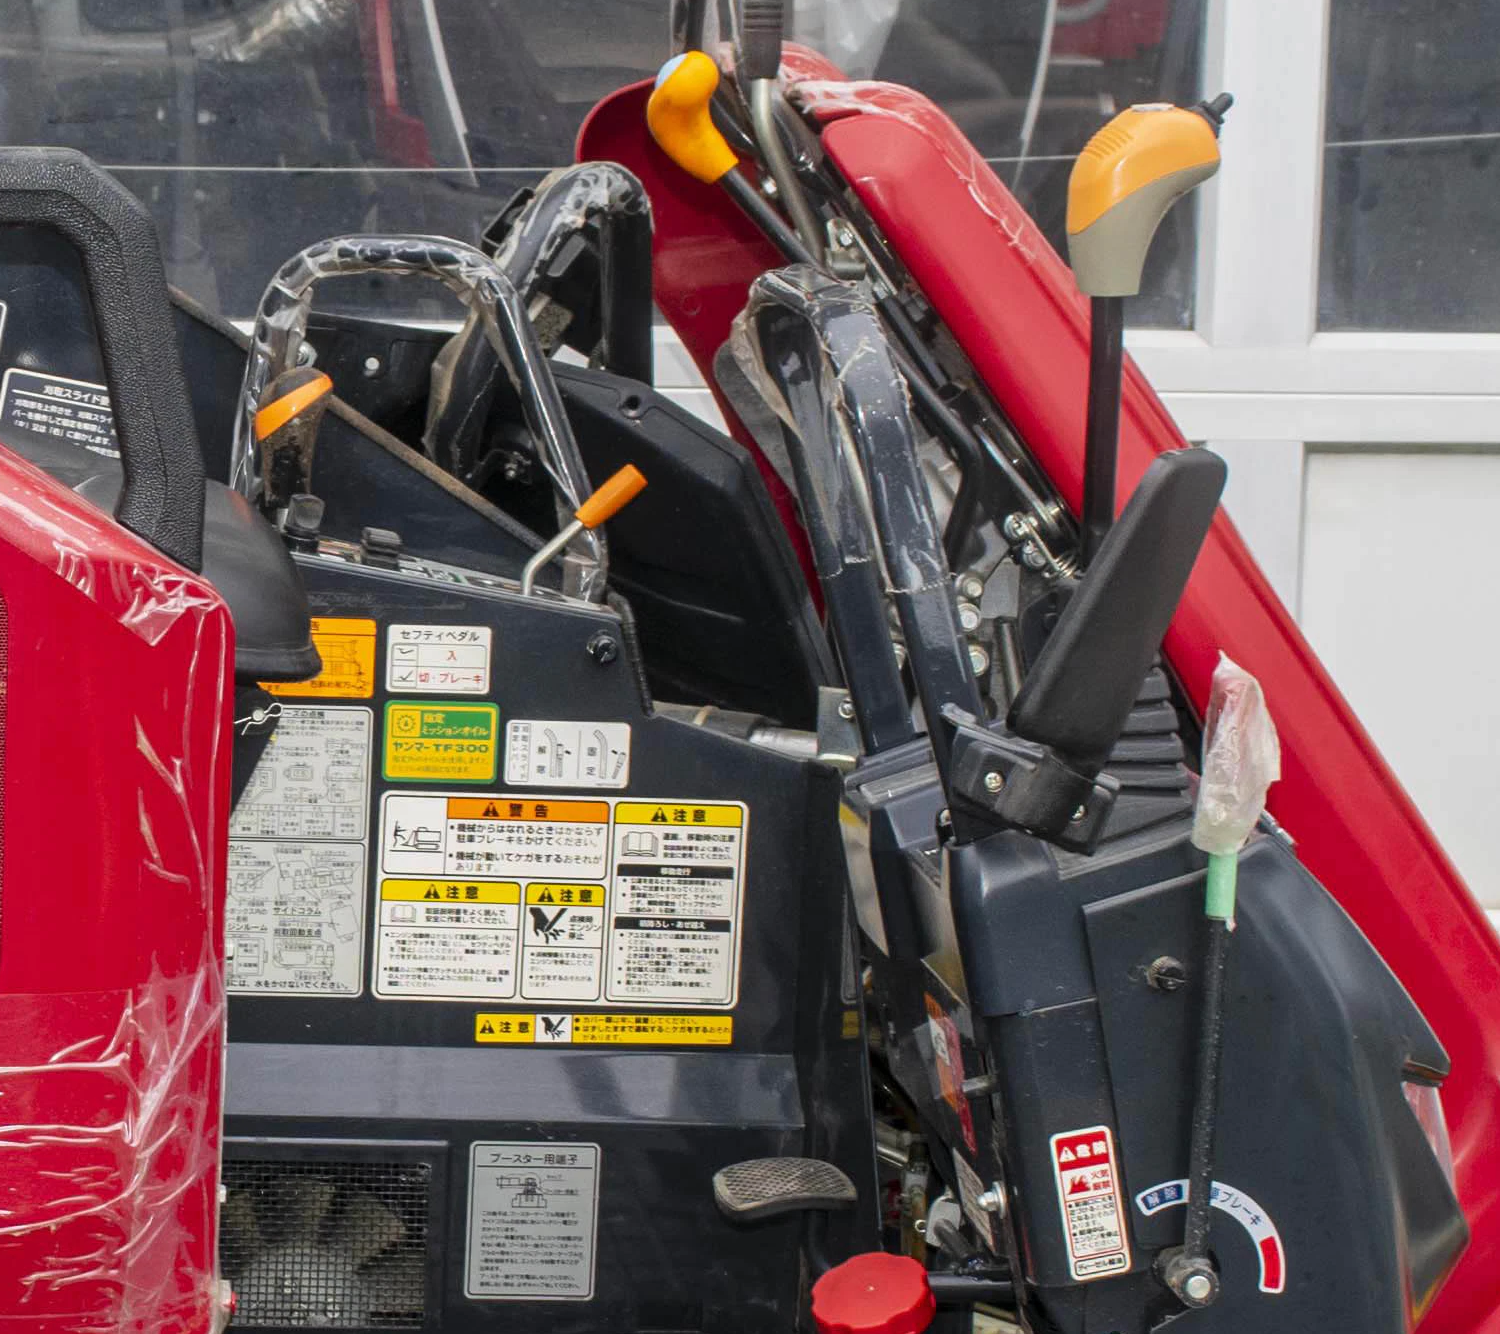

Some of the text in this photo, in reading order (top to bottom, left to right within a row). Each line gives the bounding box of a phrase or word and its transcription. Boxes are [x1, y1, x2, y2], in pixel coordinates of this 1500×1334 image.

[508, 802, 549, 818] 警告
[673, 808, 706, 823] 注意
[446, 885, 479, 900] 注意
[559, 888, 593, 903] 注意
[499, 1021, 530, 1034] 注意
